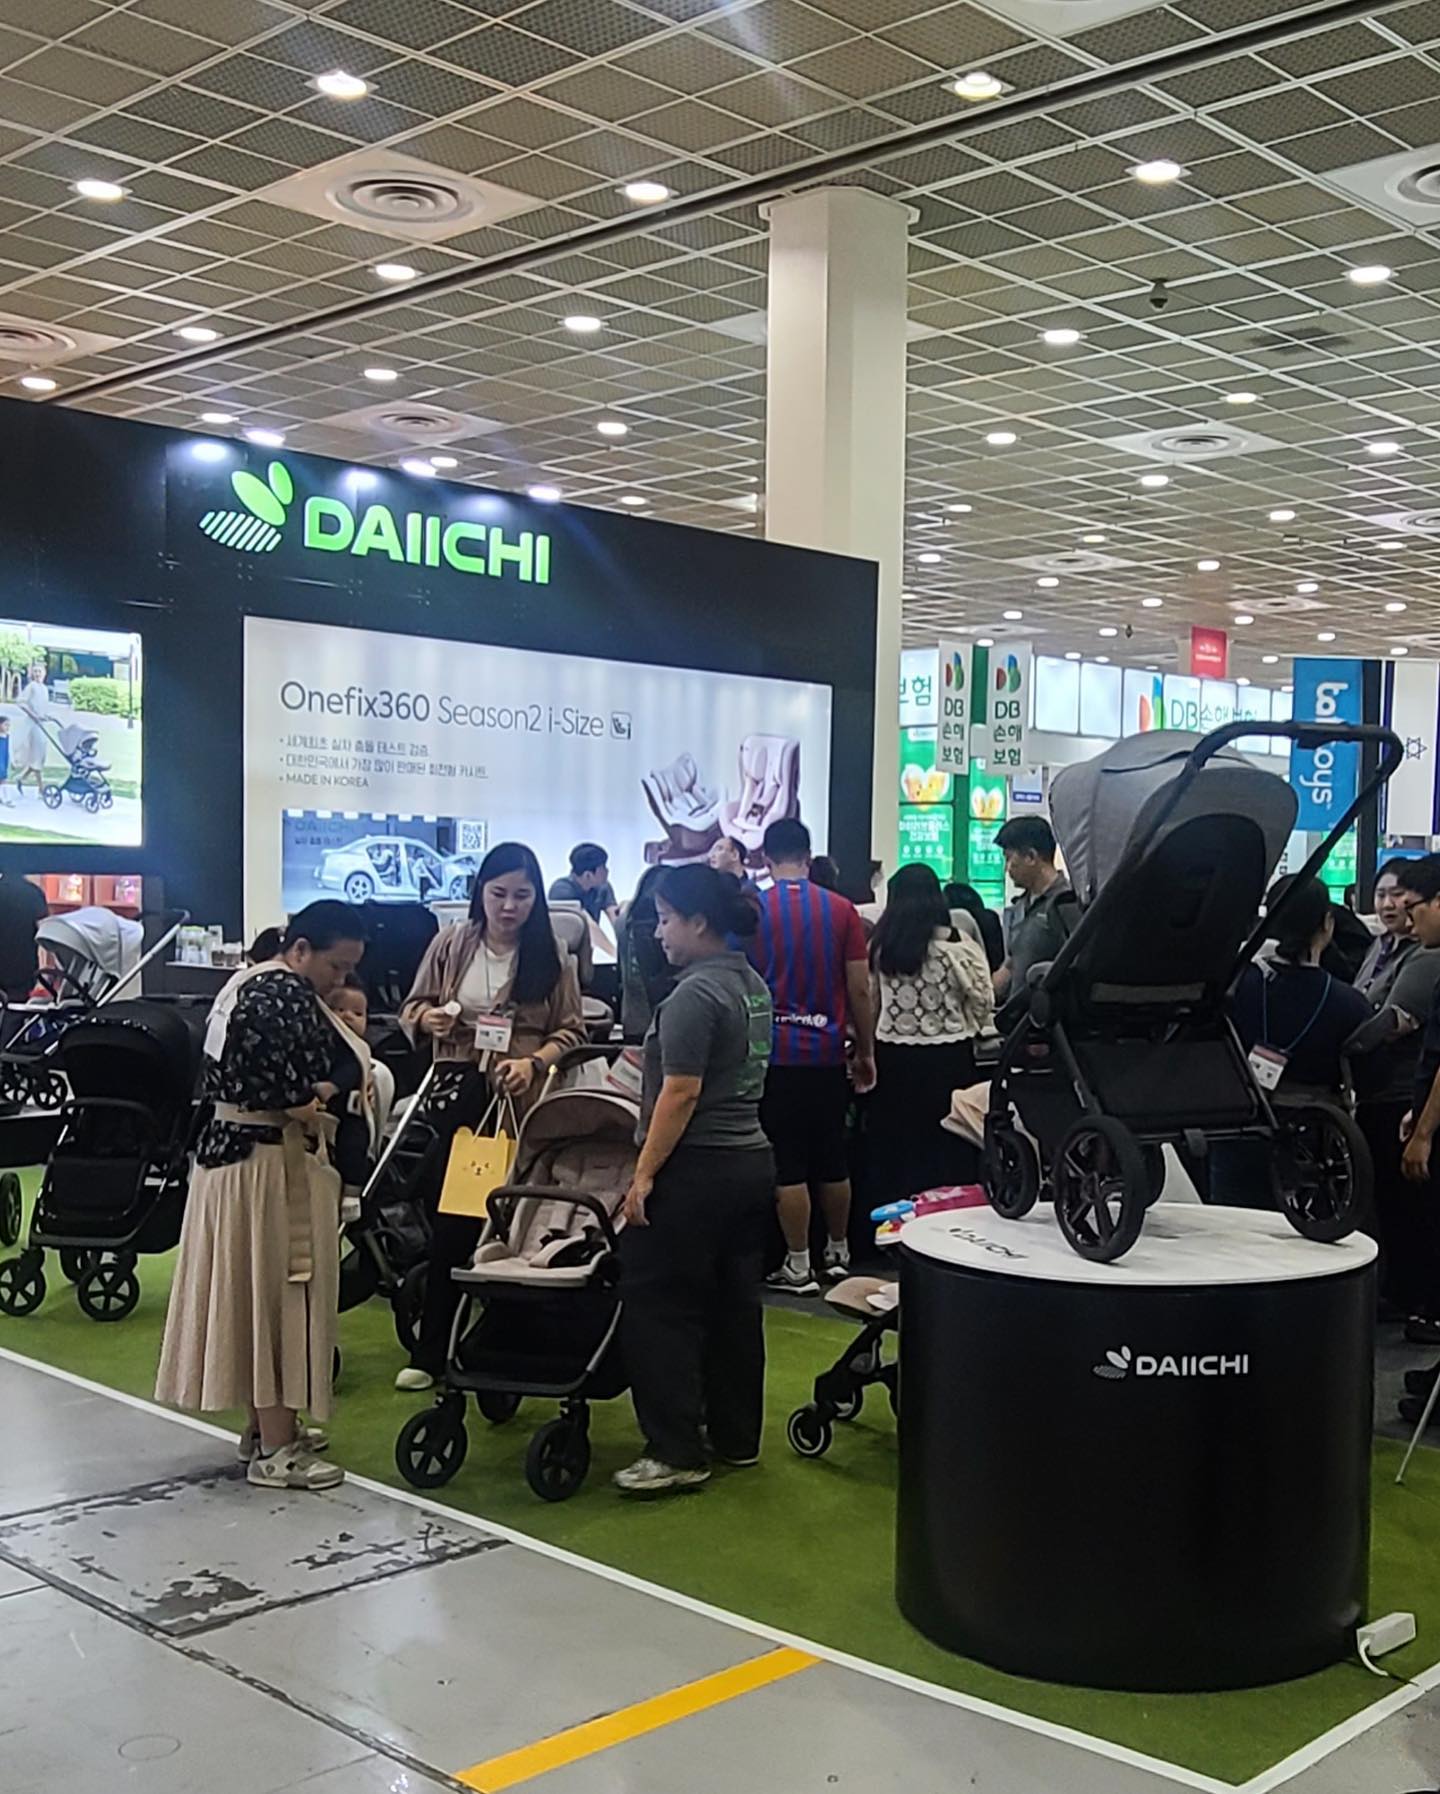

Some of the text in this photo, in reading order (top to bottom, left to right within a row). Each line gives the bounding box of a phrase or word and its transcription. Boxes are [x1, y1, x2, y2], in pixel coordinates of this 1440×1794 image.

[304, 496, 549, 584] DAIICHI
[280, 681, 605, 738] Onefix360 Season2 i-Size
[944, 697, 964, 717] DB
[994, 700, 1020, 719] DB
[993, 725, 1022, 743] 손해
[377, 740, 406, 755] 테스트
[941, 745, 963, 765] 보험
[993, 748, 1021, 766] 보험
[286, 754, 349, 771] 대한민국에서
[351, 757, 372, 773] 가장
[374, 759, 394, 774] 많이
[286, 773, 369, 788] MADE IN KOREA
[1136, 1354, 1249, 1377] DAIICHI
